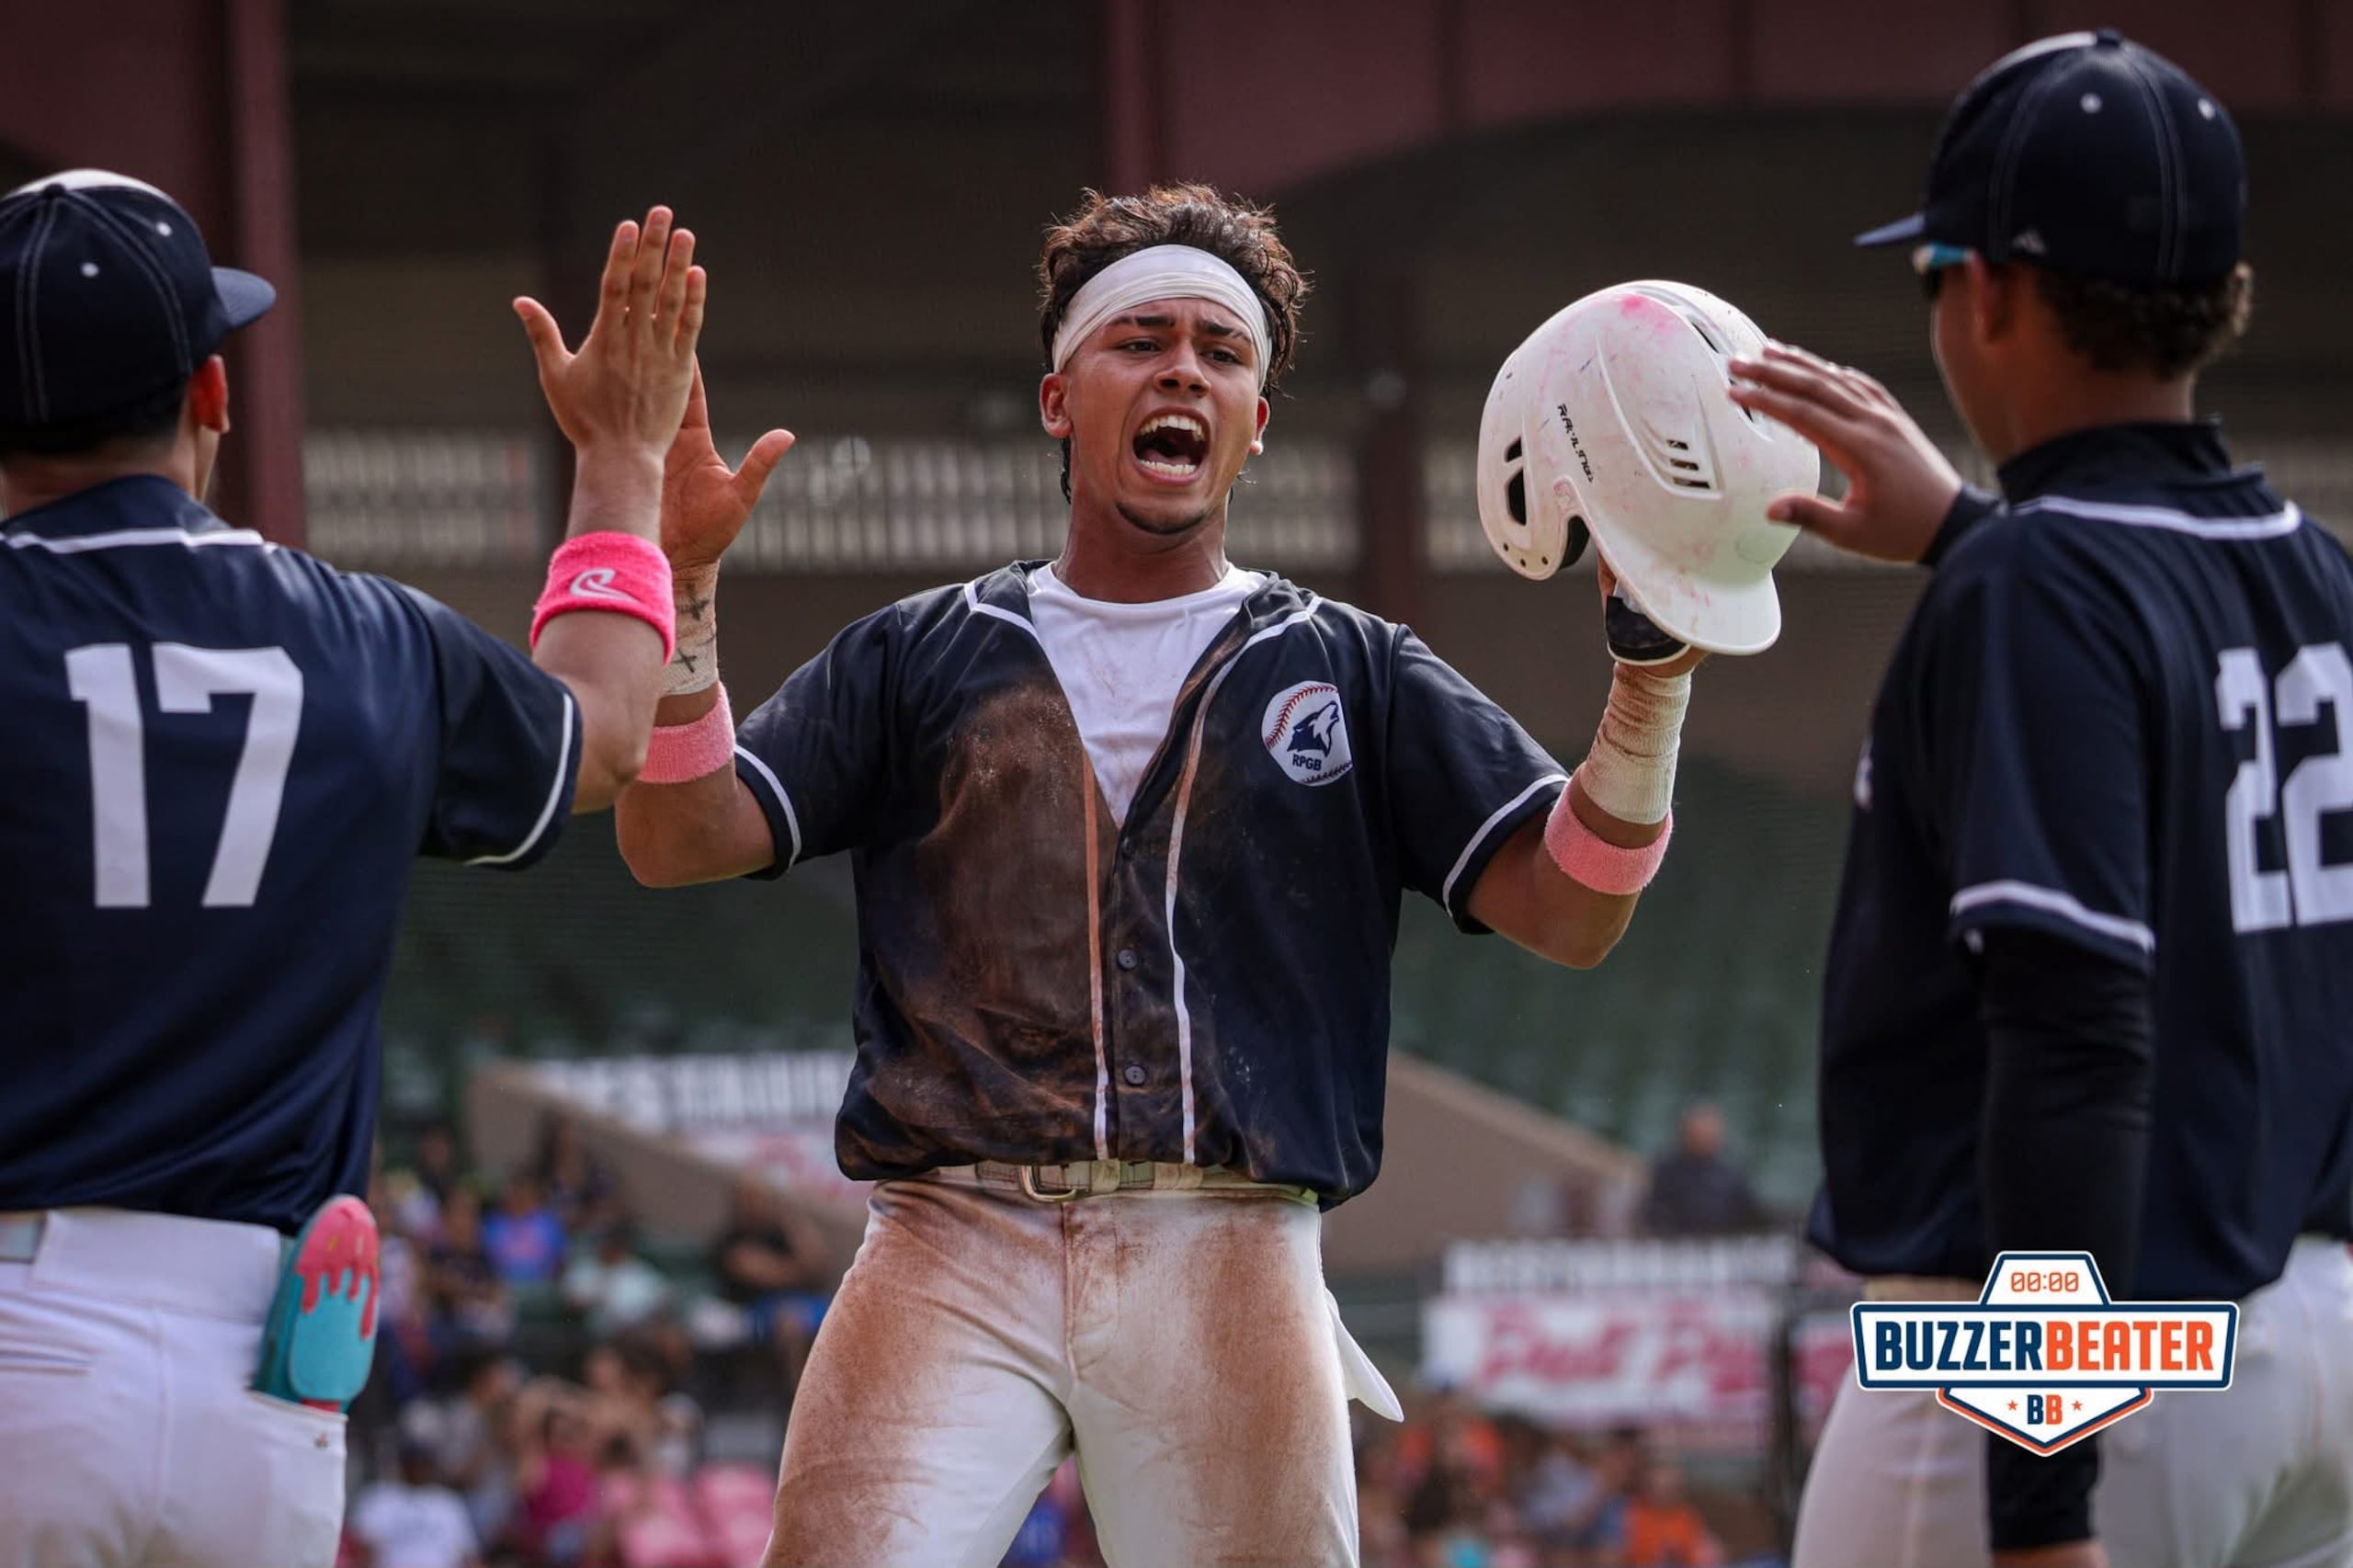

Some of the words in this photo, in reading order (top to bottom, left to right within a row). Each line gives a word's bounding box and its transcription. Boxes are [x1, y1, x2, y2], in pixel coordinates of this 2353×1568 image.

[64, 642, 304, 908] 17
[1292, 754, 1322, 771] RPGB
[2215, 642, 2353, 935] 22
